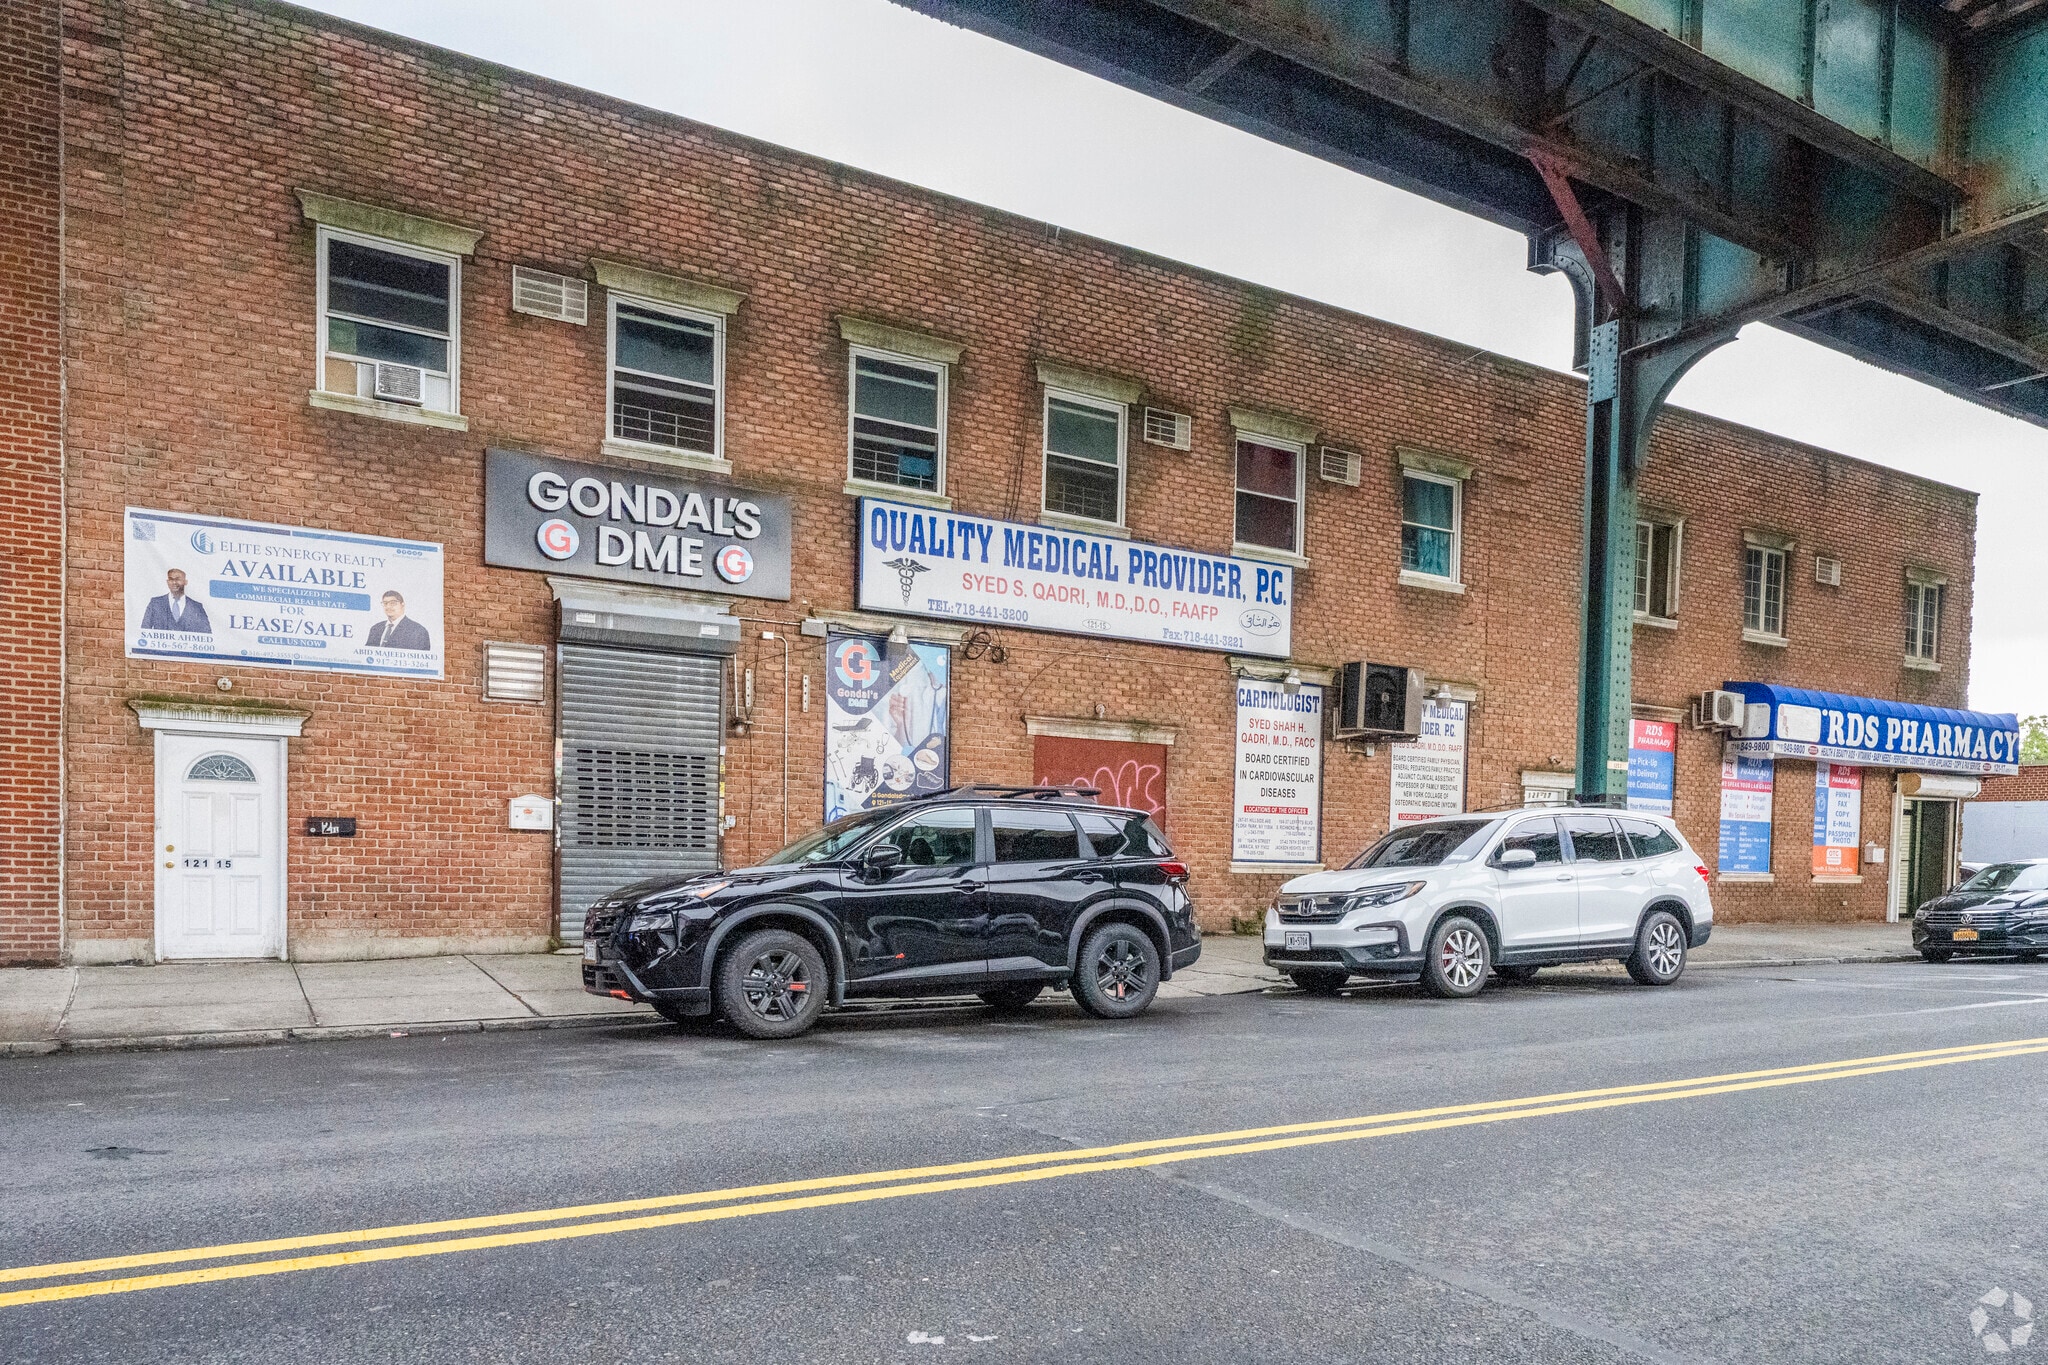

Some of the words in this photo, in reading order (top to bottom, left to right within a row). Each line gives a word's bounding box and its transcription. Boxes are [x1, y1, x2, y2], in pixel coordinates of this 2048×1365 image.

[528, 471, 761, 539] GONDAL'S
[220, 541, 261, 555] ELITE
[265, 546, 330, 562] SYNERGY
[335, 554, 386, 568] REALTY
[544, 523, 571, 553] G
[598, 525, 704, 576] DME
[723, 550, 746, 576] G
[870, 507, 993, 564] QUALITY
[1003, 528, 1119, 582] MEDICAL
[1128, 547, 1247, 603] PROVIDER,
[1256, 567, 1287, 606] P.C.
[220, 559, 366, 589] AVAILABLE
[267, 587, 320, 598] SPECIALIZED
[962, 572, 1008, 595] SYED
[1013, 580, 1028, 598] S.
[1033, 582, 1090, 608] QADRI,
[1172, 601, 1218, 622] FAAFP
[235, 593, 292, 604] COMMERCIAL
[295, 598, 316, 607] REAL
[317, 600, 347, 609] ESTATE
[280, 606, 305, 616] FOR
[229, 615, 354, 639] LEASE/SALE
[141, 631, 175, 640] SABBIR
[177, 634, 214, 643] AHMED
[261, 636, 286, 644] CALL
[286, 637, 298, 645] US
[300, 639, 322, 647] NOW
[150, 640, 215, 652] 516-567-8600
[353, 648, 373, 656] ABID
[375, 650, 406, 658] MAJEED
[837, 687, 879, 700] Gondal's
[1238, 688, 1320, 713] CARDIOLOGIST
[1429, 705, 1464, 721] MEDICAL
[1249, 718, 1271, 730] SYED
[1273, 720, 1296, 732] SHAH
[1298, 722, 1306, 733] H.
[1645, 724, 1663, 737] RDS
[1241, 732, 1270, 746] QADRI,
[1294, 737, 1316, 748] FACC
[1637, 736, 1671, 748] PHARMACY
[1827, 710, 1879, 748] RDS
[1885, 718, 2018, 762] PHARMACY
[1740, 741, 1770, 751] 849-9800
[1245, 753, 1272, 764] BOARD
[1273, 755, 1310, 766] CERTIFIED
[1637, 757, 1658, 768] Pick-Up
[1239, 770, 1247, 780] IN
[1249, 770, 1315, 783] CARDIOVASCULAR
[1637, 769, 1658, 780] Delivery
[1636, 781, 1668, 791] Consultation
[1260, 788, 1296, 799] DISEASES
[184, 859, 208, 868] 121
[216, 860, 232, 868] 15
